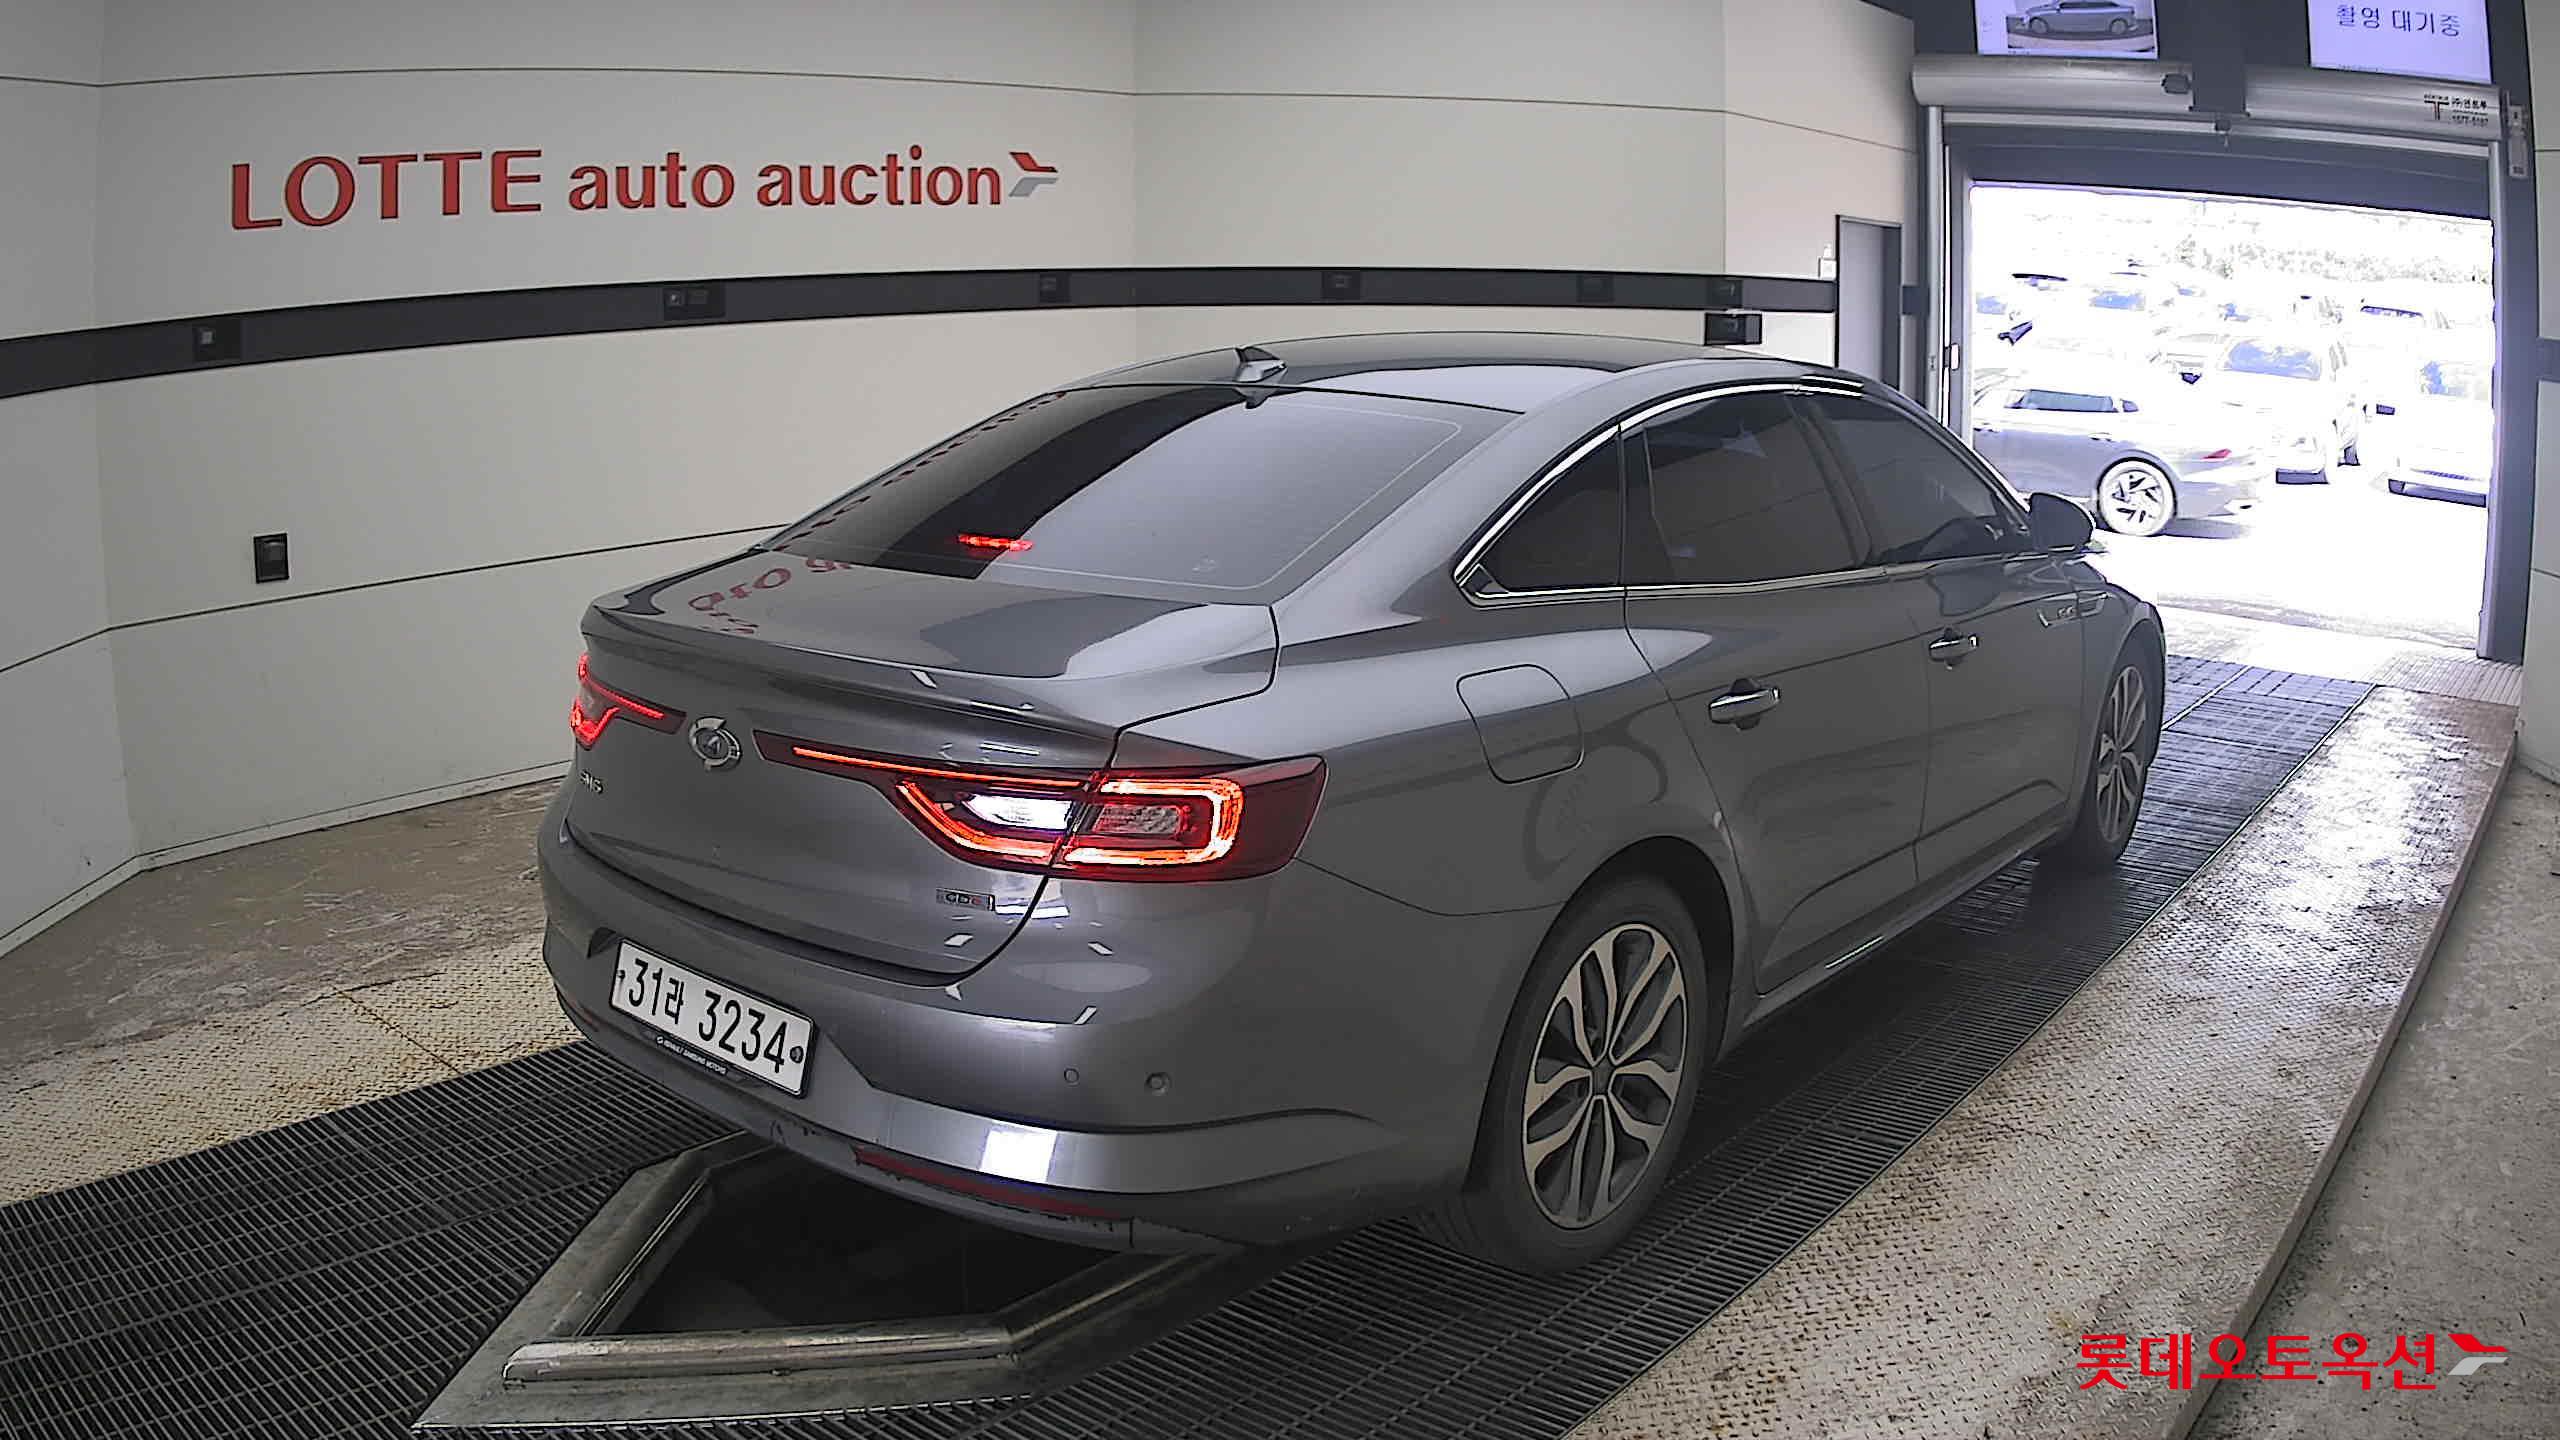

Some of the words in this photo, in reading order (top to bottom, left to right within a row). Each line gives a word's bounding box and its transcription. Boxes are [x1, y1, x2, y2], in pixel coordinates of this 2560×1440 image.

[2391, 9, 2460, 38] 대기중
[231, 149, 543, 231] LOTTE
[568, 151, 736, 210] auto
[756, 144, 1002, 207] auction
[628, 957, 685, 1025] 31라
[699, 989, 786, 1074] 3234
